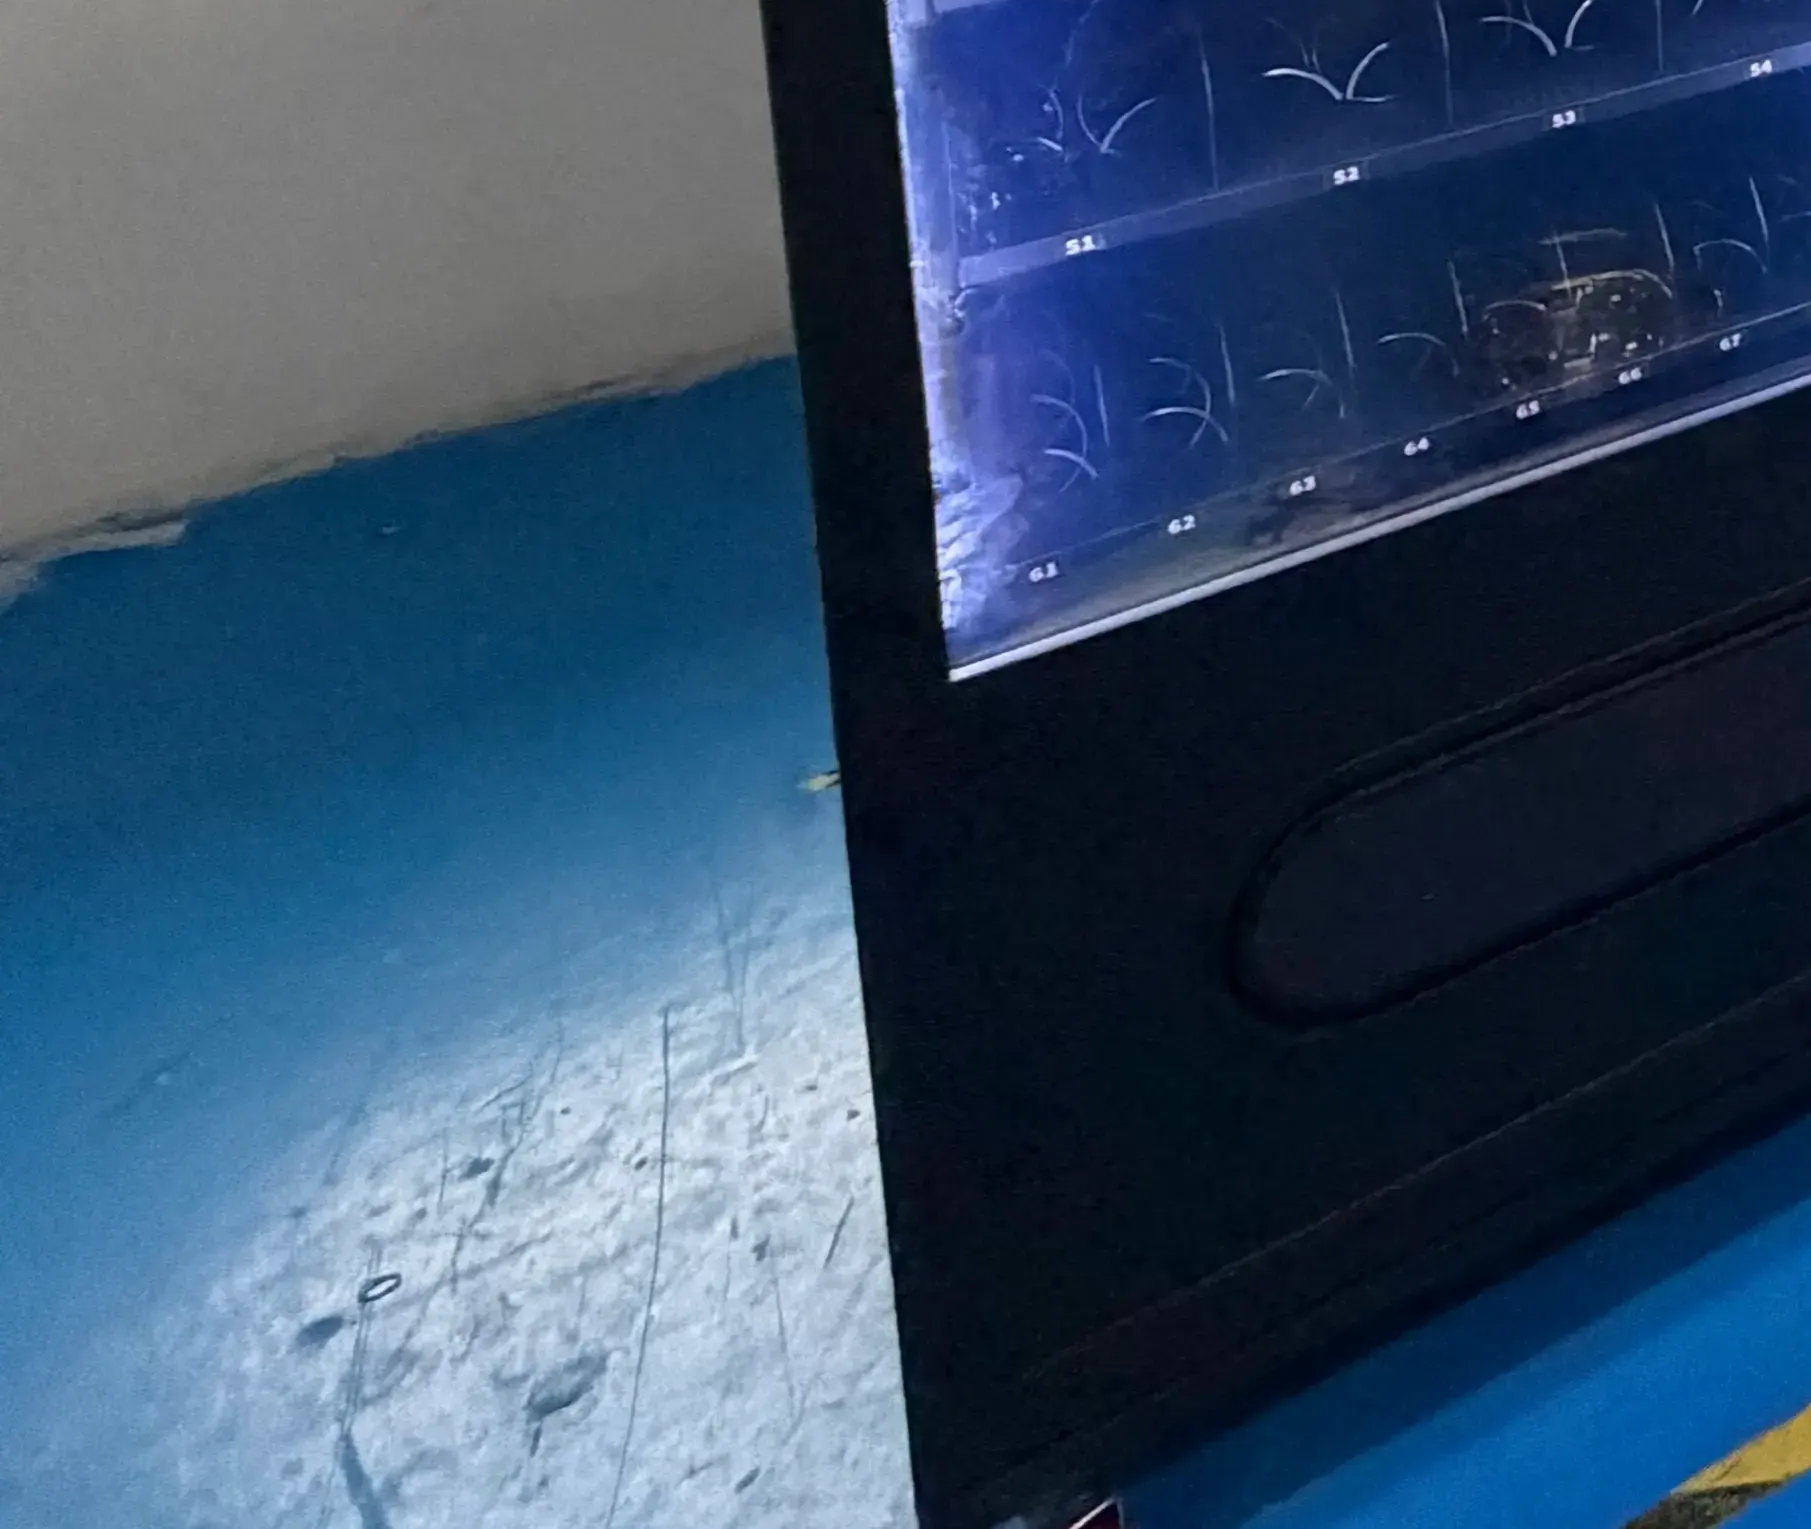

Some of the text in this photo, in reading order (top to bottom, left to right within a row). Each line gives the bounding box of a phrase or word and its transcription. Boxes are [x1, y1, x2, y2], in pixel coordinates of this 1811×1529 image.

[1065, 235, 1096, 255] 51
[1333, 166, 1359, 185] 52
[1552, 110, 1576, 128] 53
[1750, 59, 1773, 77] 54
